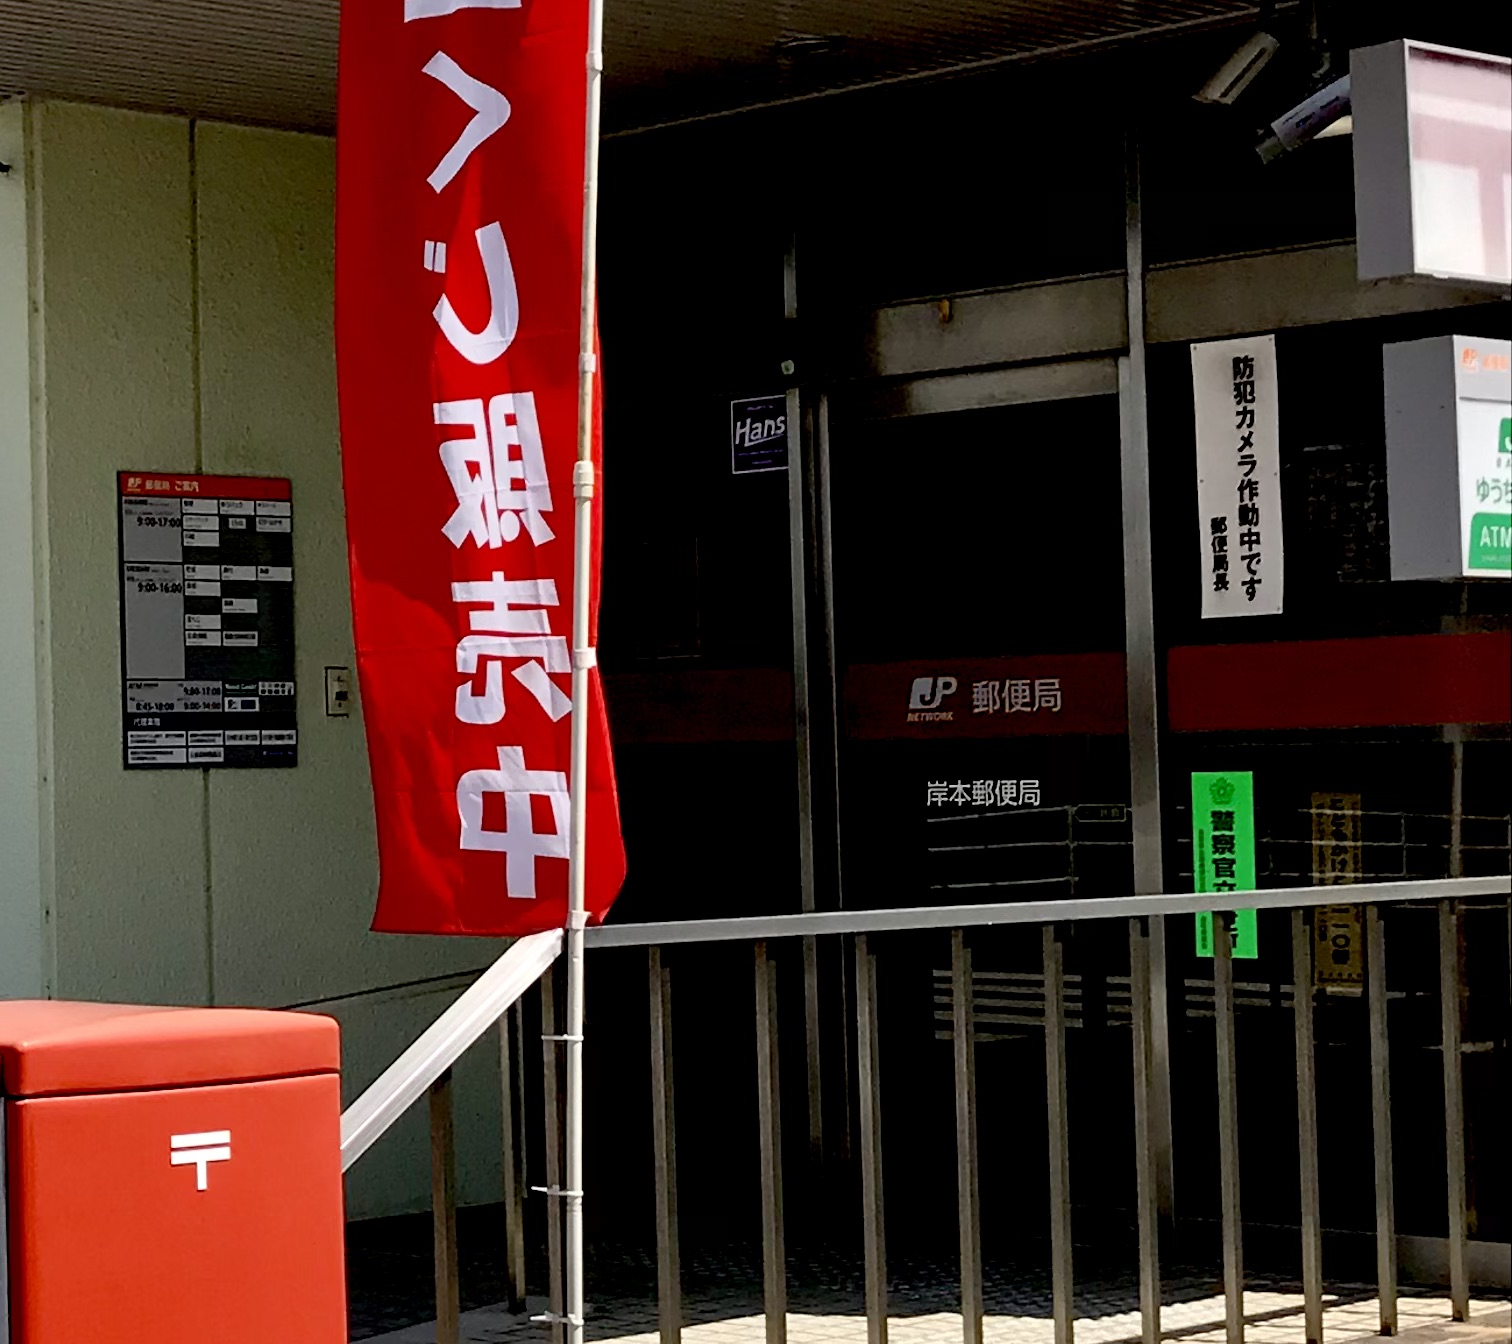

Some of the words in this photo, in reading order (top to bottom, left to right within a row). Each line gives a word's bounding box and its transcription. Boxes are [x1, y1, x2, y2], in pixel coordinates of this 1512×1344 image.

[1232, 354, 1262, 602] 防犯カメラ作動中です
[972, 678, 1062, 714] 郵便局
[926, 779, 1041, 807] 岸本郵便局
